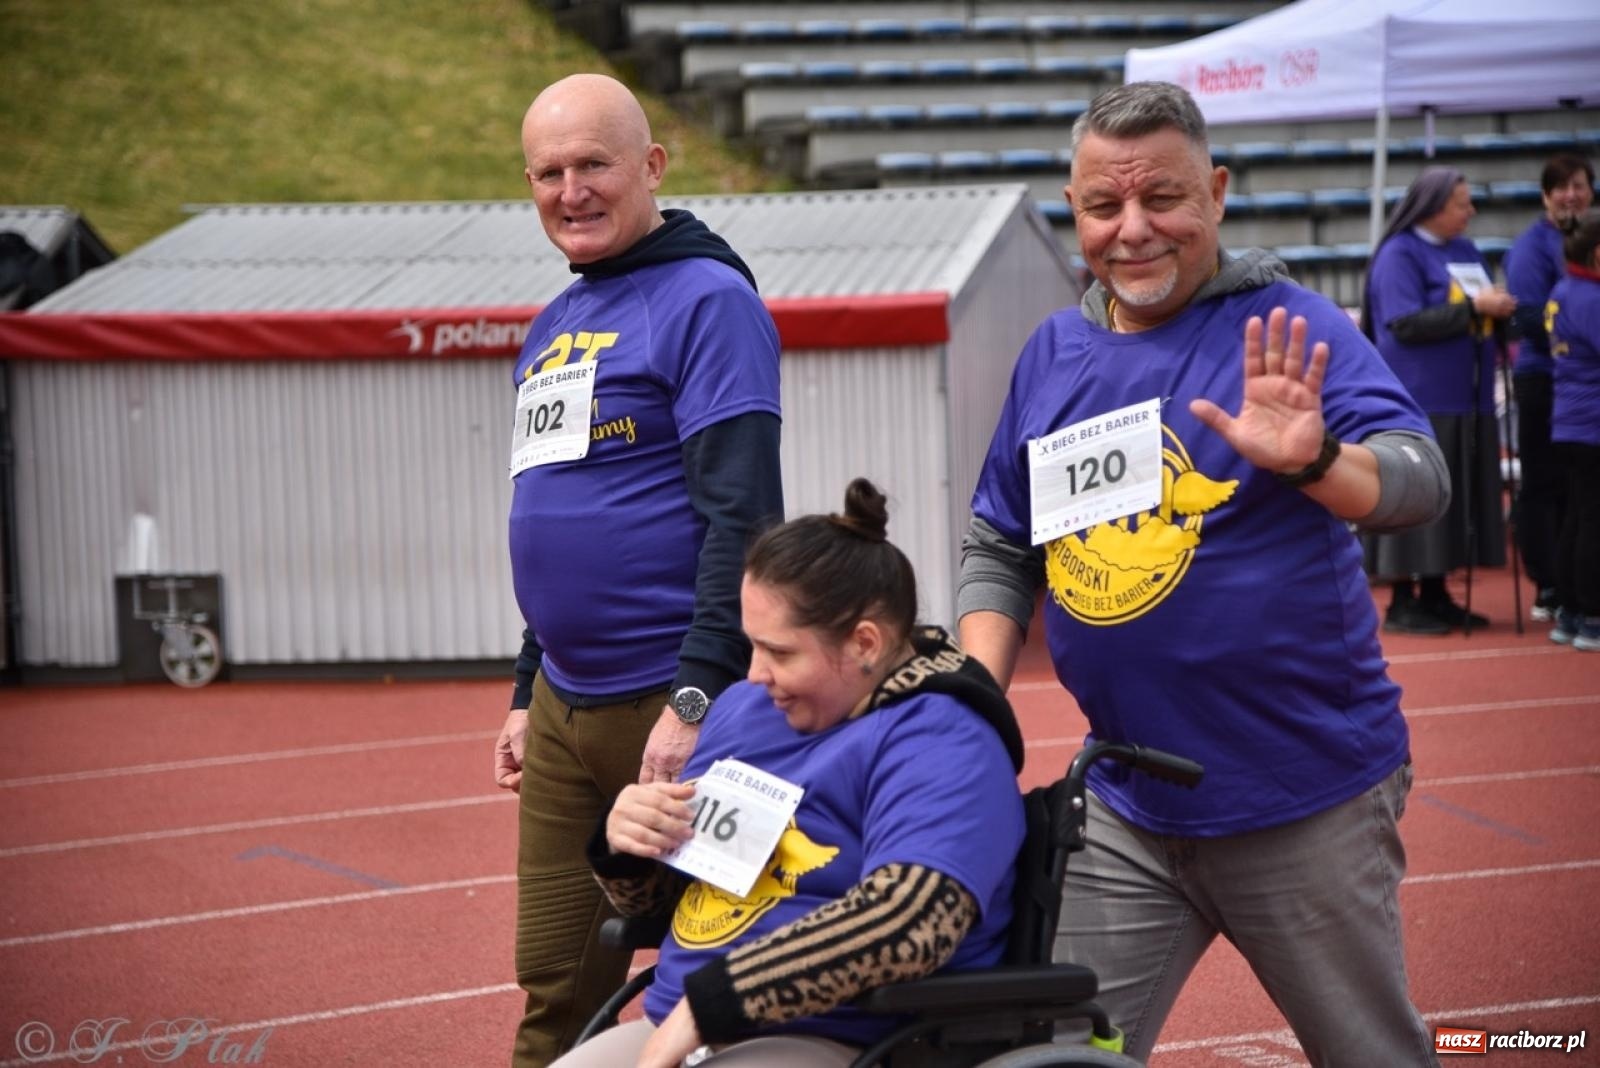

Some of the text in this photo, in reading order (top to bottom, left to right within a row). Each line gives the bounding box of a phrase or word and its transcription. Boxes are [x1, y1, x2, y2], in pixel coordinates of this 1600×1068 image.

[540, 373, 554, 388] BEZ
[555, 368, 588, 384] BARIER
[526, 399, 565, 438] 102
[1052, 433, 1076, 451] BIEG
[1080, 424, 1102, 440] BEZ
[1105, 410, 1150, 432] BARIER
[1066, 448, 1127, 496] 120
[1050, 540, 1111, 593] CIBORSKI
[1073, 577, 1153, 612] BIEG BEZ BARIER
[724, 768, 743, 783] BEZ
[744, 775, 789, 803] BARIER
[690, 795, 741, 842] 116
[700, 911, 733, 937] BARIER
